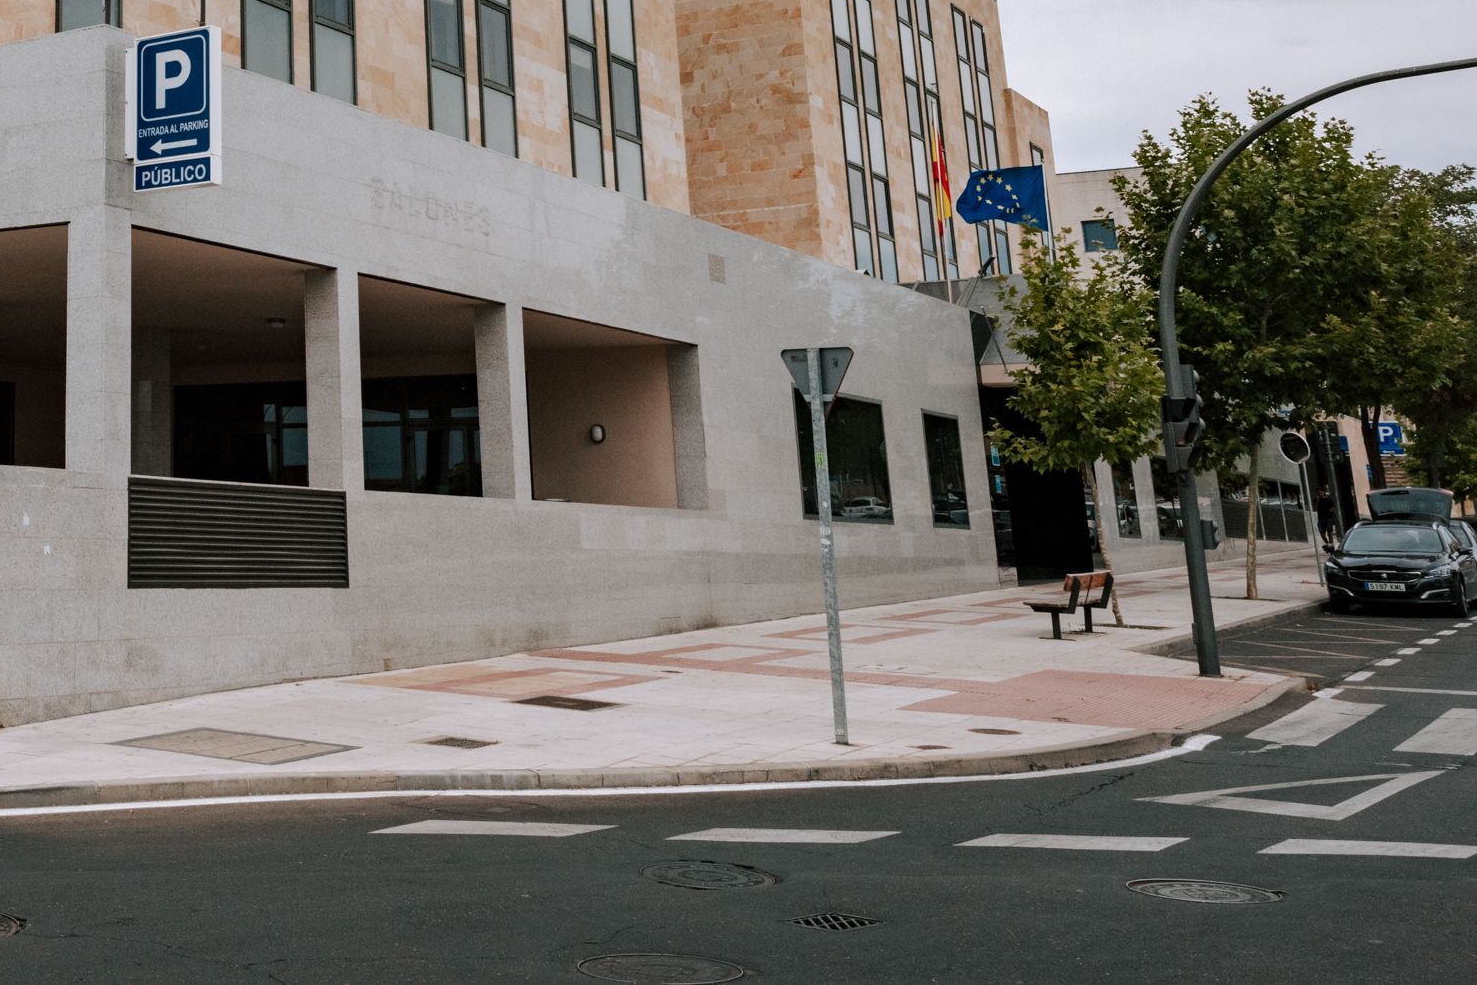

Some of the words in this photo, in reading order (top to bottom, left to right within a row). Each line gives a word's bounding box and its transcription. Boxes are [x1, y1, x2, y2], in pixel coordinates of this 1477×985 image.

[155, 49, 191, 110] P
[138, 125, 169, 139] ENTRADA
[169, 123, 178, 134] AL
[179, 119, 209, 133] PARKING
[141, 163, 206, 187] PÚBLICO
